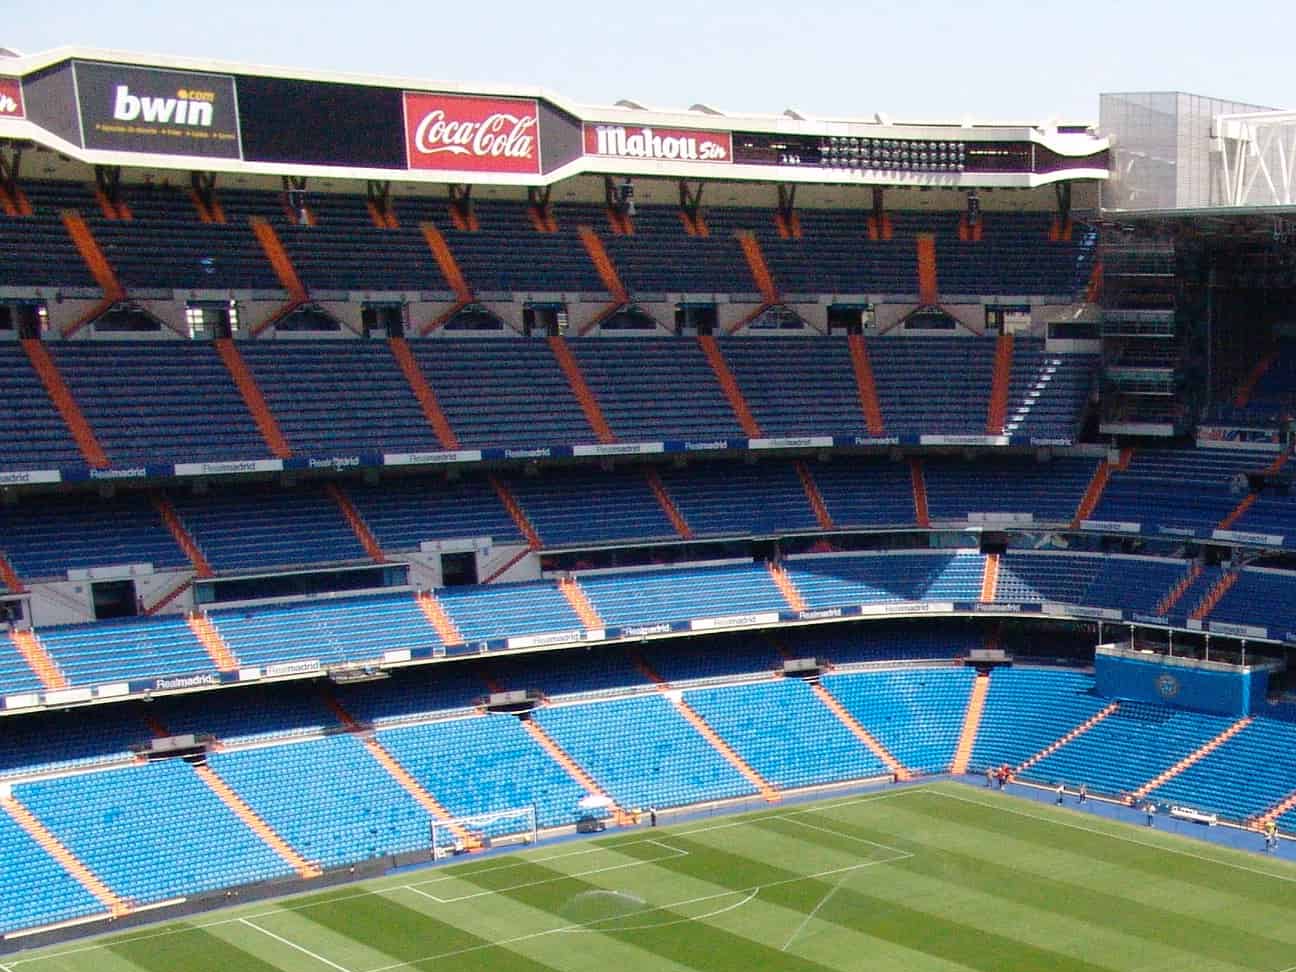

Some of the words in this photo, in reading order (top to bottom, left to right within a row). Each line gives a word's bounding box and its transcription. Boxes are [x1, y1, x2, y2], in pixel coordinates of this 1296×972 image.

[114, 86, 213, 126] bwin
[415, 110, 537, 158] Coca-Cola
[596, 126, 698, 159] Mahou
[699, 141, 727, 160] Sin
[156, 675, 213, 690] Realmadrid
[269, 661, 319, 675] Realmadrid
